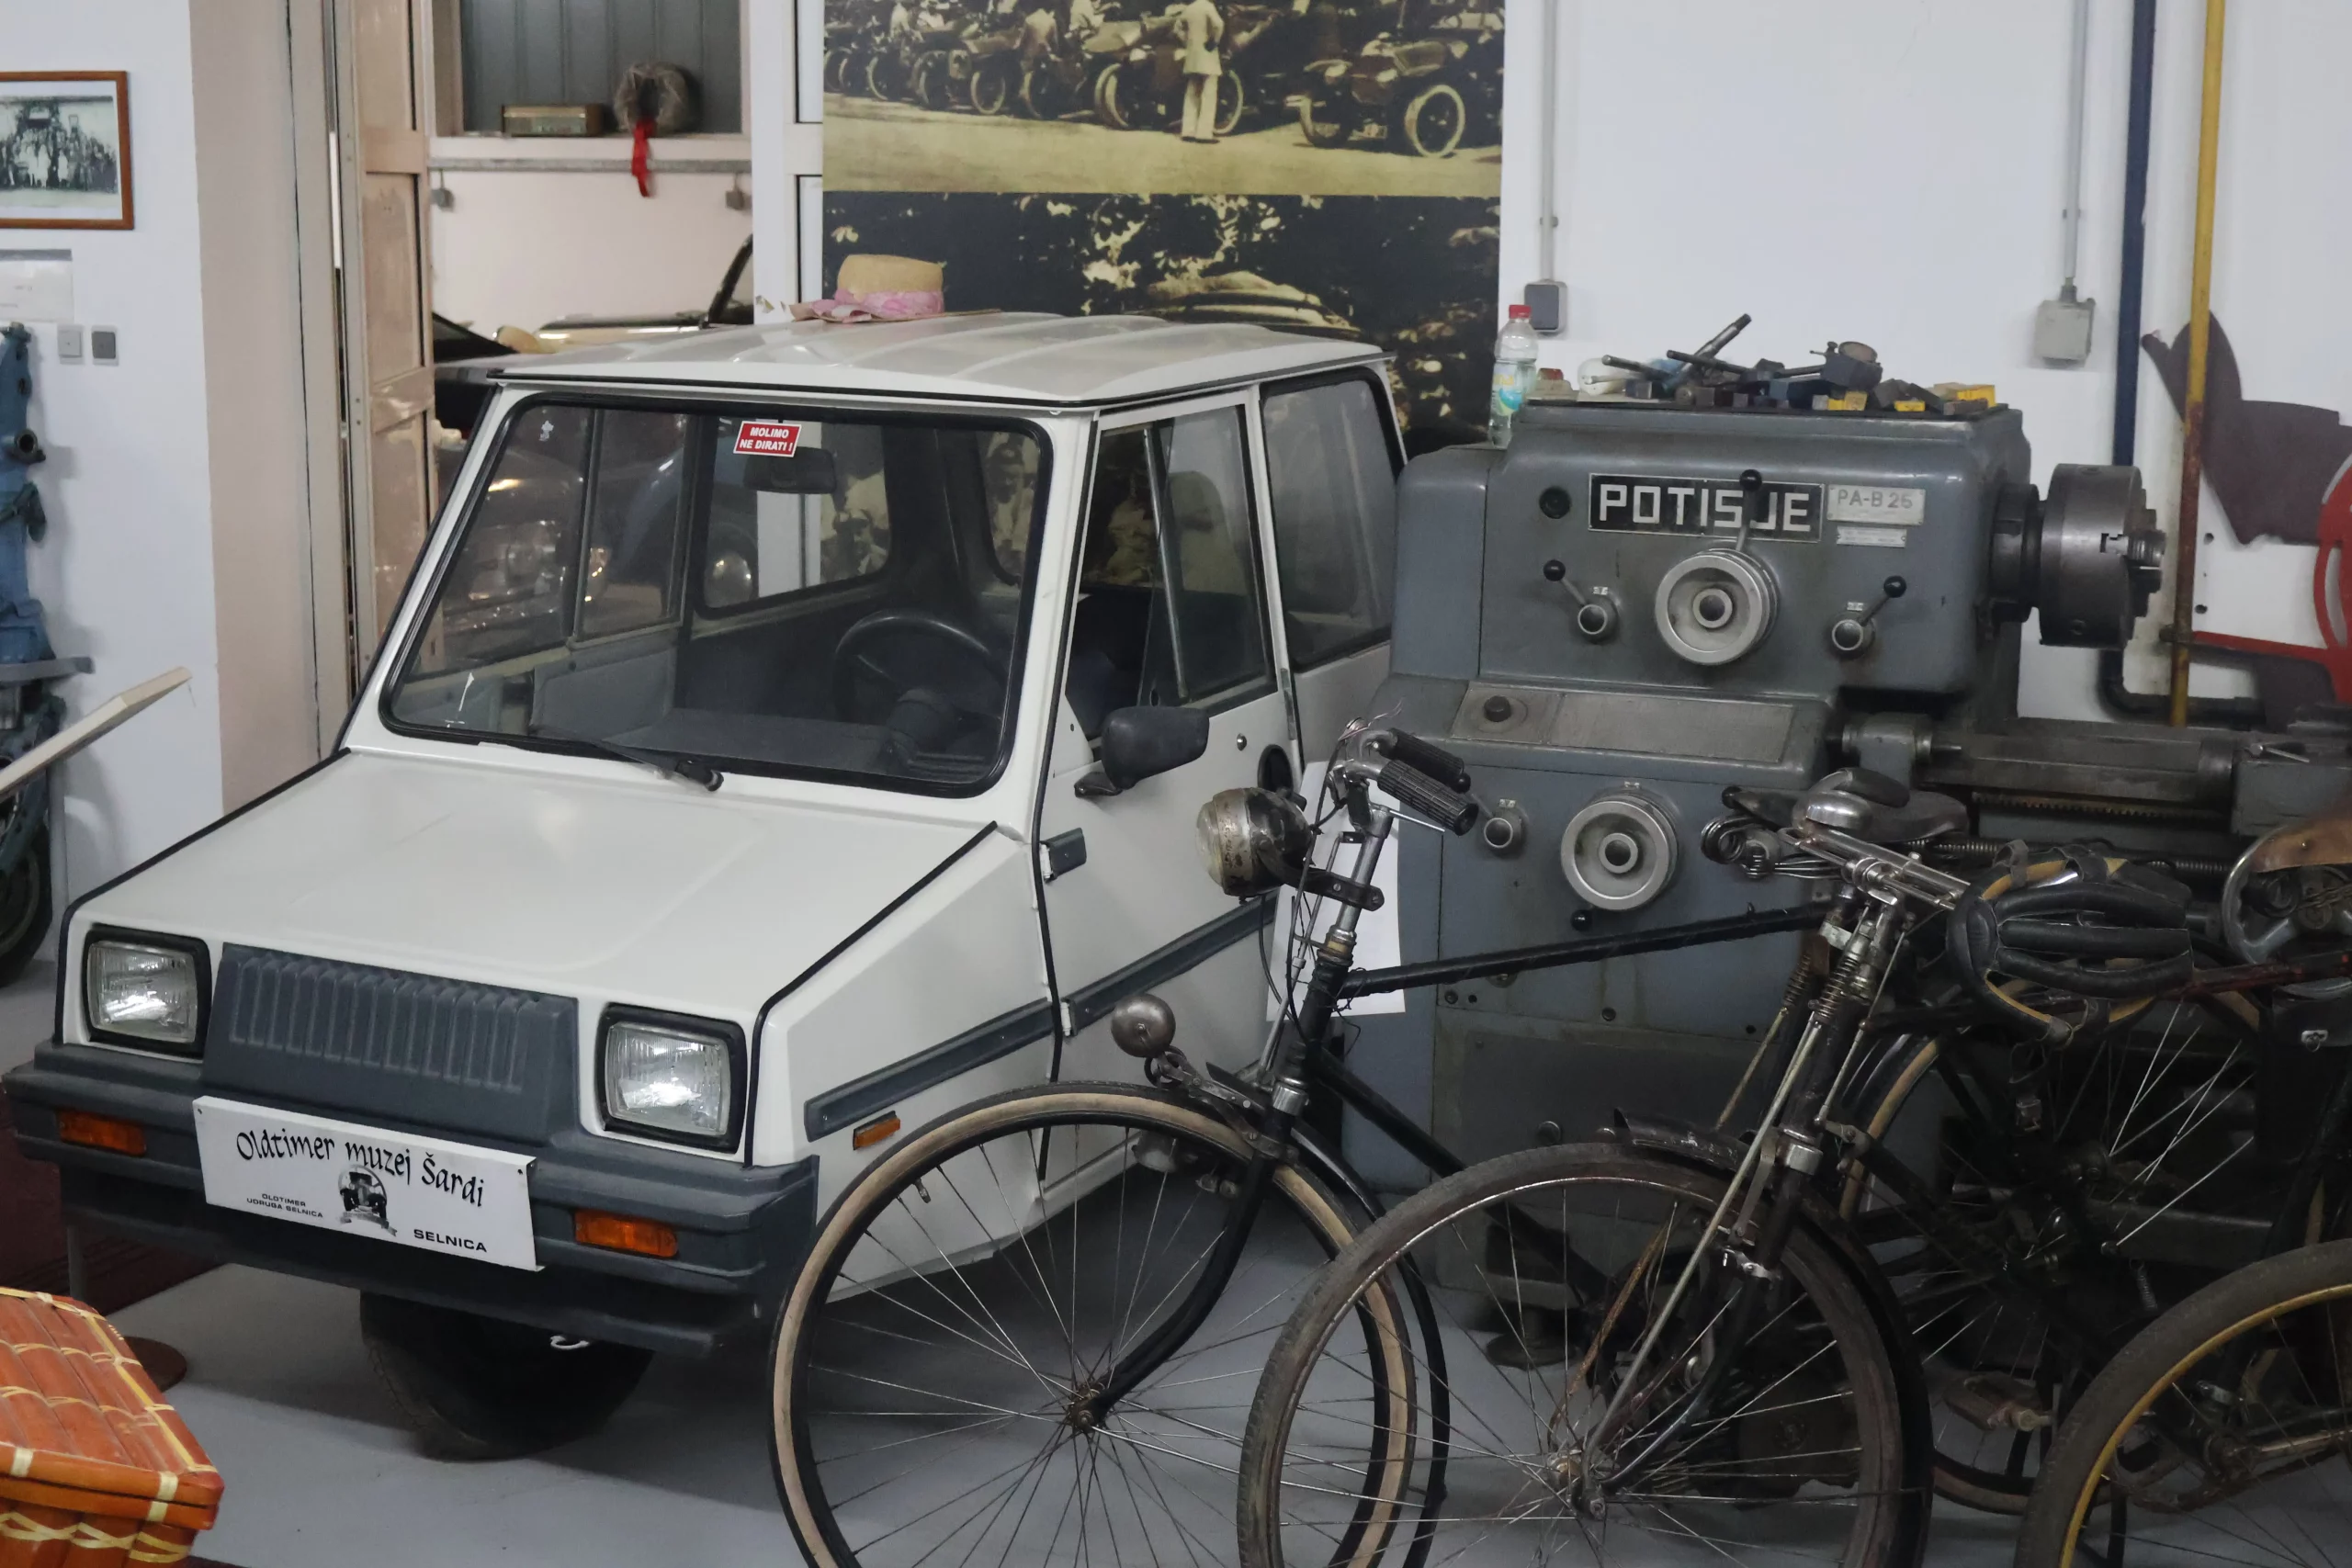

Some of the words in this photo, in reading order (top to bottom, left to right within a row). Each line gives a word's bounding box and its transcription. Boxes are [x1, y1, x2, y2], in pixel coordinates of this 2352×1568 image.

[750, 426, 789, 439] MOLIMO
[740, 439, 753, 449] NE
[755, 440, 787, 451] DIRATI
[1599, 483, 1812, 532] POTISJE
[236, 1128, 335, 1161] Oldtimer
[345, 1142, 411, 1186] muzej
[421, 1151, 485, 1208] Šardi
[246, 1197, 283, 1211] UDRUGA
[285, 1205, 324, 1219] SELNICA
[261, 1193, 307, 1208] OLDTIMER
[413, 1228, 488, 1253] SELNICA
